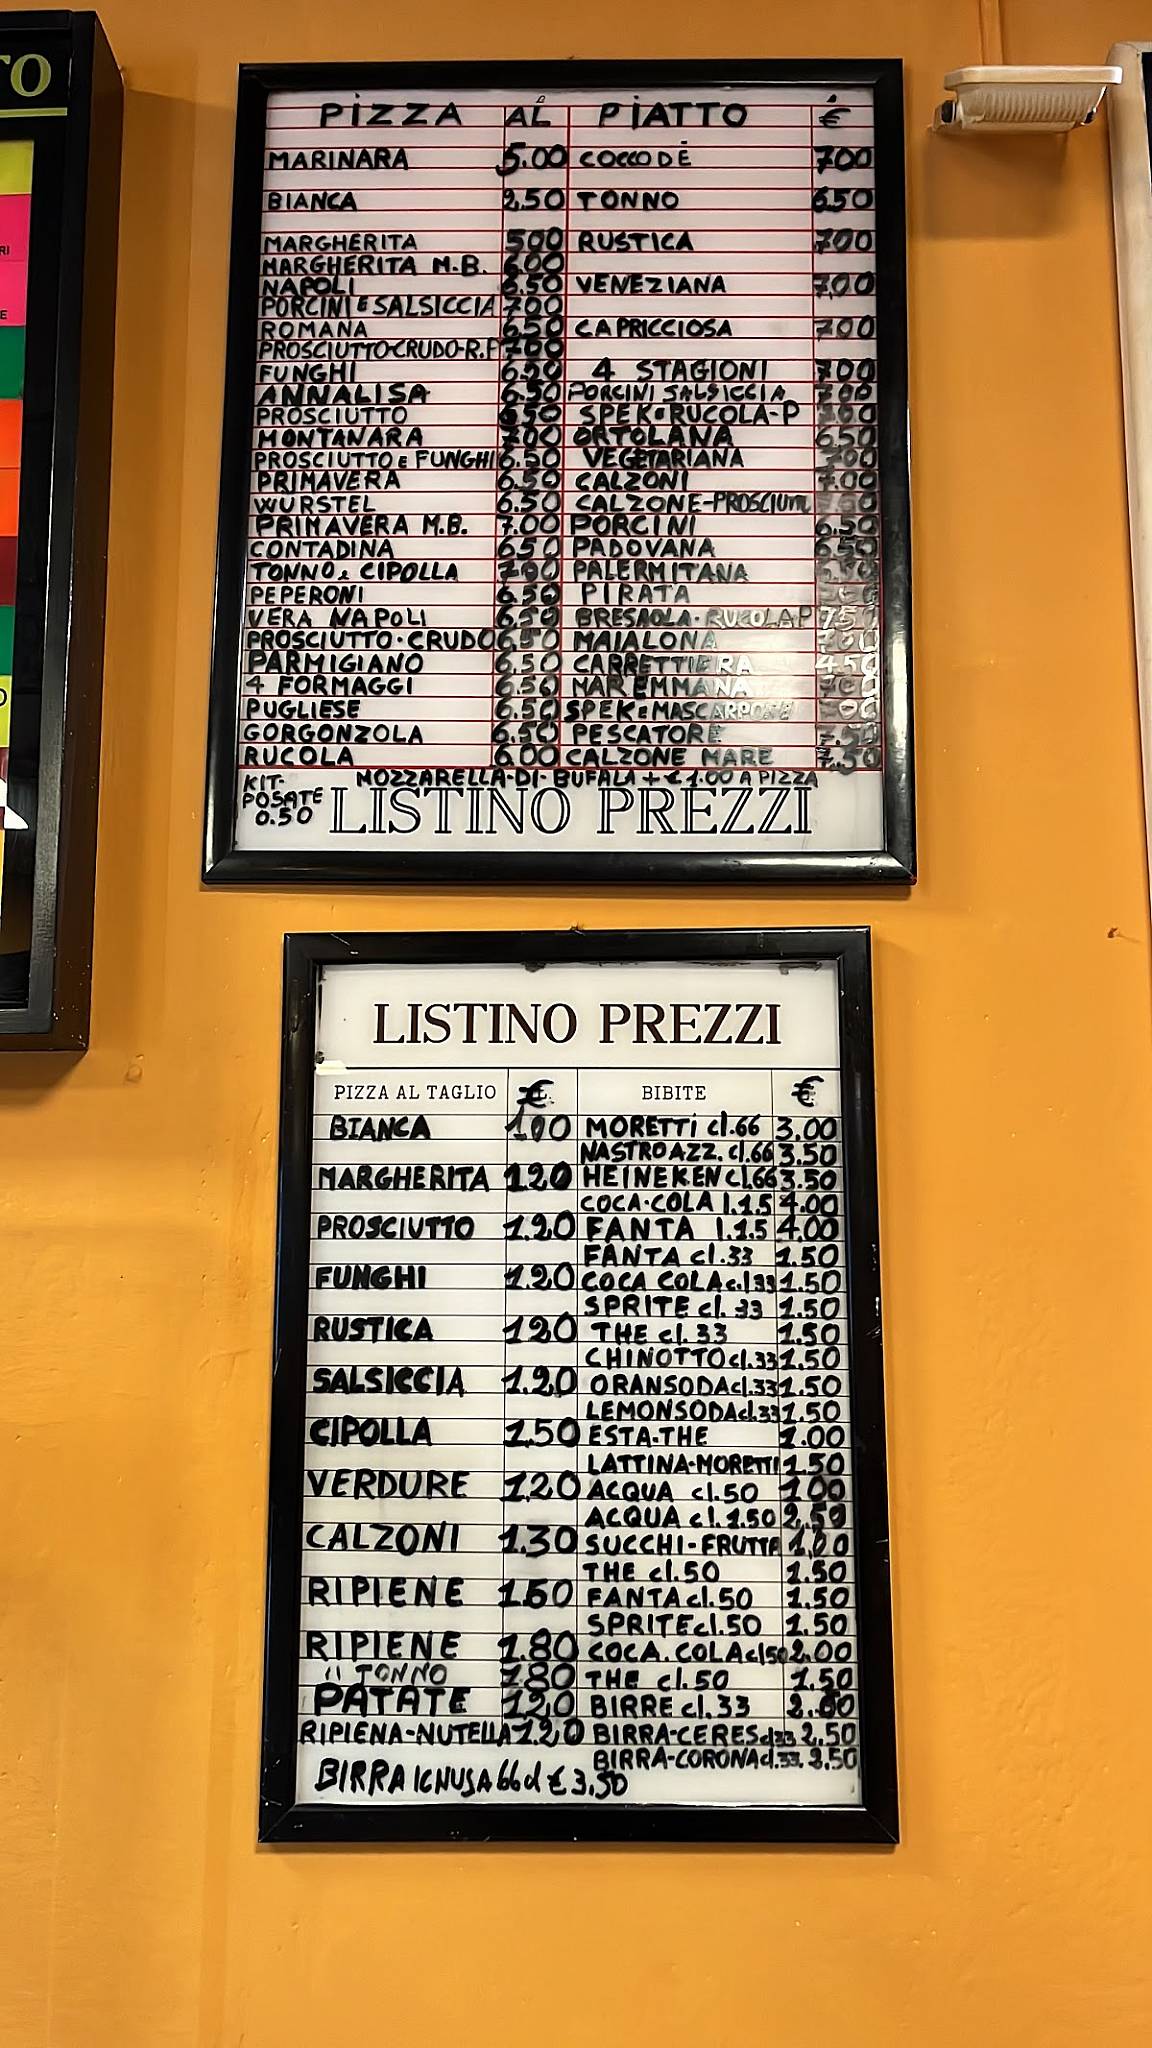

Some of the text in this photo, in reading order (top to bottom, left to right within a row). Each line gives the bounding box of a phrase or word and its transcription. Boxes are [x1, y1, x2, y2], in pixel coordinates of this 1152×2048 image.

[269, 142, 567, 176] MARINARA 5.00
[268, 192, 357, 211] BIANCA
[577, 192, 679, 211] TONNO
[264, 234, 417, 251] MARGHERITA
[578, 231, 694, 251] RUSTICA
[262, 255, 487, 276] MARGHERITA M.B.
[262, 277, 354, 296] NAPOLI
[576, 274, 726, 294] VENEZIANA
[261, 296, 496, 317] PORCINI SALSICCIA
[261, 321, 367, 339] ROMANA
[575, 318, 733, 337] CAPRICCIOSA
[259, 362, 356, 383] FUNGHI
[591, 357, 615, 382] 4
[636, 360, 767, 382] STAGIONI
[258, 384, 430, 405] ANNALISA
[568, 383, 785, 402] PORCINI SALSICCIA
[256, 406, 407, 425] PROSCIUTTO
[258, 427, 423, 449] MONTANARA
[573, 426, 733, 446] ORTOLANA
[255, 447, 561, 469] PROSCIUTTO FUNGHI 6.50
[582, 448, 744, 468] VEGETARIANA
[257, 471, 400, 492] PRIMAVERA
[575, 471, 688, 491] CALZONI
[254, 491, 561, 514] WURSTEL 6.50
[255, 513, 560, 536] PRIMAVERA M.B. 7.00
[570, 514, 696, 536] PORCINI
[250, 539, 394, 559] CONTADINA
[573, 537, 716, 558] PADOVANA
[254, 562, 334, 581] TONNO
[360, 562, 458, 583] CIPOLLA
[574, 560, 749, 584] PALERMITANA
[251, 585, 363, 605] PEPERONI
[582, 585, 690, 605] PIRATA
[249, 607, 426, 628] VERA NAPOLI
[573, 631, 717, 651] MAIALONA
[250, 650, 423, 673] PARMIGIANO
[574, 653, 751, 675] CARRETTIERA
[245, 675, 265, 694] 4
[278, 676, 412, 695] FORMAGGI
[246, 696, 560, 721] PUGLIESE 6.50
[243, 720, 559, 744] GORGONZOLA 6.50
[573, 723, 722, 744] PESCATORE
[244, 746, 354, 767] RUCOLA
[566, 748, 773, 767] CALZONE MARE
[740, 771, 750, 785] A
[759, 771, 818, 787] PIZZA
[243, 787, 323, 809] POSATE
[255, 807, 313, 827] 0.50
[329, 787, 813, 835] LISTINO PREZZI
[373, 1003, 782, 1044] LISTINO PREZZI
[335, 1085, 496, 1100] PIZZA AL TAGLIO
[642, 1086, 706, 1101] BIBITE
[329, 1115, 431, 1142] BIANCA
[775, 1117, 837, 1142] 3.00
[778, 1143, 837, 1167] 3.50
[319, 1164, 489, 1192] MARGHERITA
[584, 1164, 837, 1191] HEINEKEN 3.50
[779, 1191, 838, 1216] 4.00
[317, 1215, 474, 1240] PROSCIUTTO
[586, 1215, 839, 1243] FANTA 4.00
[584, 1243, 838, 1267] FANTA 1.50
[316, 1264, 426, 1290] FUNGHI
[581, 1270, 841, 1294] COCA COLA 1.50
[584, 1294, 690, 1317] SPRITE
[779, 1297, 839, 1320] 1.50
[313, 1316, 433, 1343] RUSTICA
[591, 1322, 840, 1346] THE 33 1.50
[585, 1347, 840, 1370] CHINOTTO 1.50
[313, 1365, 467, 1397] SALSICCIA
[591, 1373, 841, 1398] ORANSODA 1.50
[587, 1400, 841, 1423] LEMONSODA 1.50
[309, 1415, 432, 1447] CIPOLLA
[589, 1425, 844, 1448] ESTA-THE 1.00
[783, 1452, 844, 1475] 1.50
[307, 1468, 470, 1499] VERDURE
[587, 1479, 673, 1502] ACQUA
[585, 1505, 680, 1528] ACQUA
[306, 1521, 459, 1556] CALZONI
[583, 1561, 847, 1583] THE 1.50
[309, 1575, 464, 1607] RIPIENE
[588, 1587, 849, 1609] FANTA 1.50
[588, 1612, 847, 1637] SPRITE 1.50
[306, 1631, 461, 1661] RIPIENE
[356, 1663, 447, 1685] TONNO
[585, 1667, 852, 1691] THE 1.50
[314, 1682, 471, 1717] PATATE
[591, 1694, 672, 1718] BIRRE
[315, 1757, 628, 1800] BIRRA 3.50
